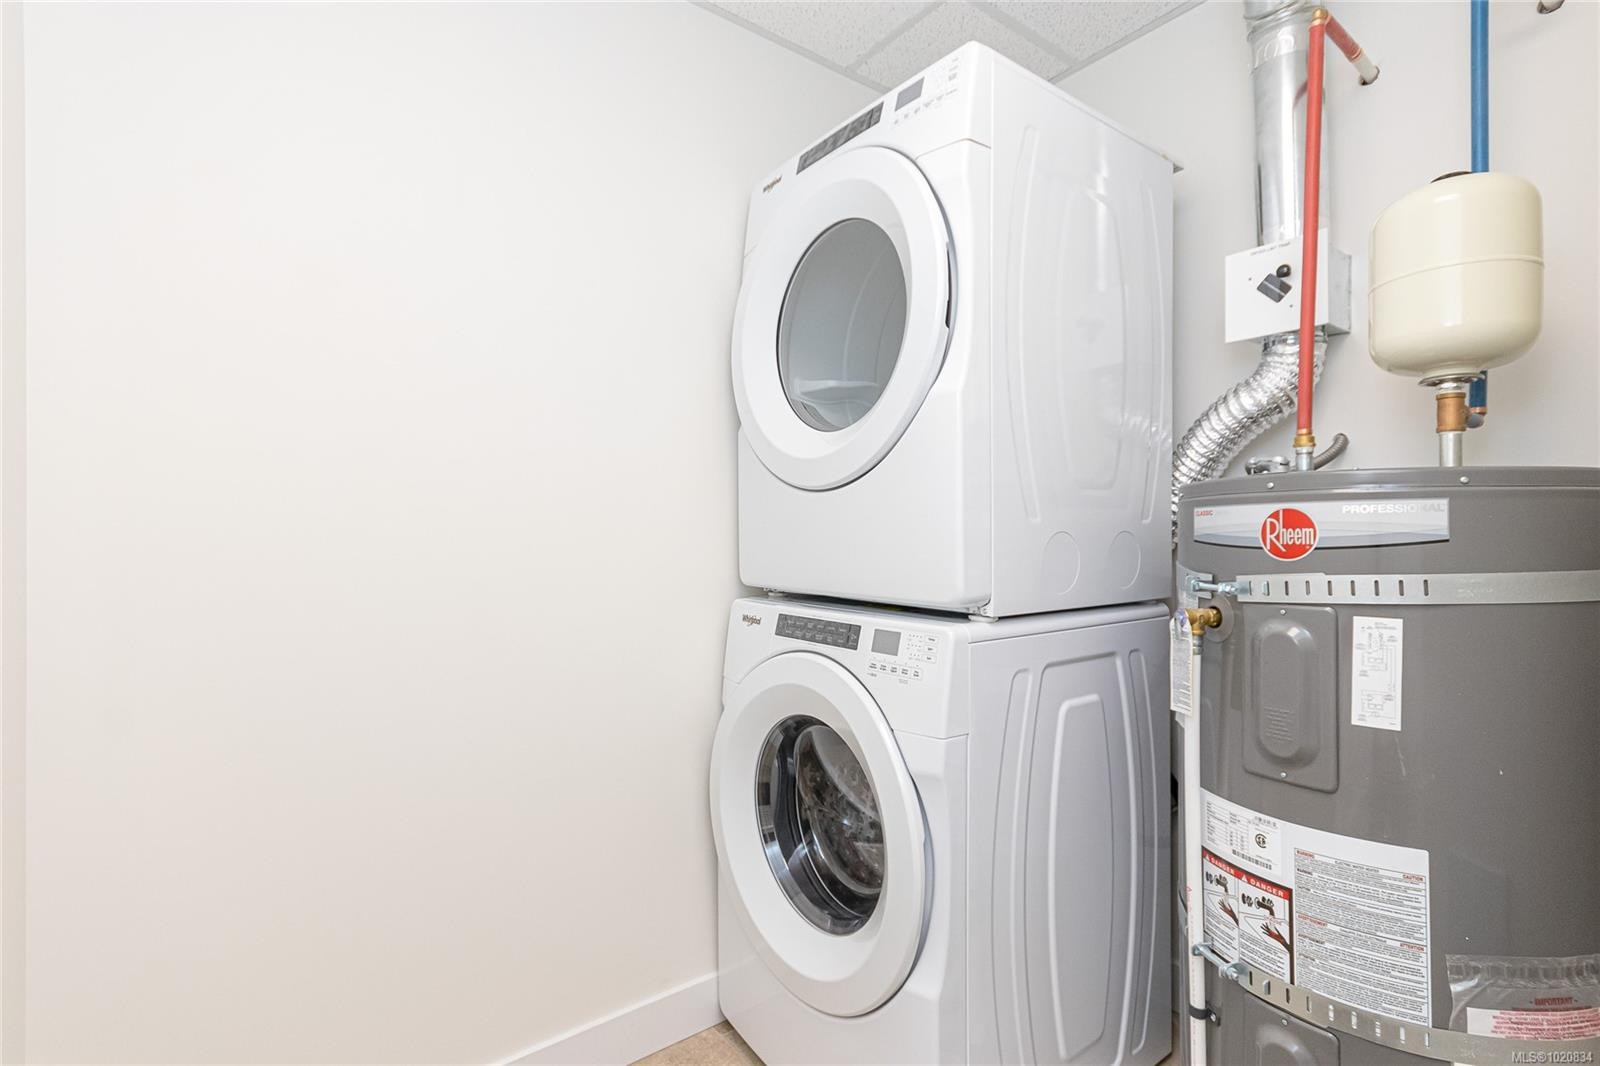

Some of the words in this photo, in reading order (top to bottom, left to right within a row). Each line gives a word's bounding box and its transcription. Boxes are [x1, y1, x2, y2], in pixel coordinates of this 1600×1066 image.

[1342, 502, 1446, 514] PROFESSIONAL
[1266, 510, 1314, 552] Rheem
[742, 614, 762, 627] Whirlpool
[1402, 874, 1424, 882] CAUTION
[1250, 878, 1285, 899] DANGER
[1535, 997, 1574, 1006] IMPORTANT
